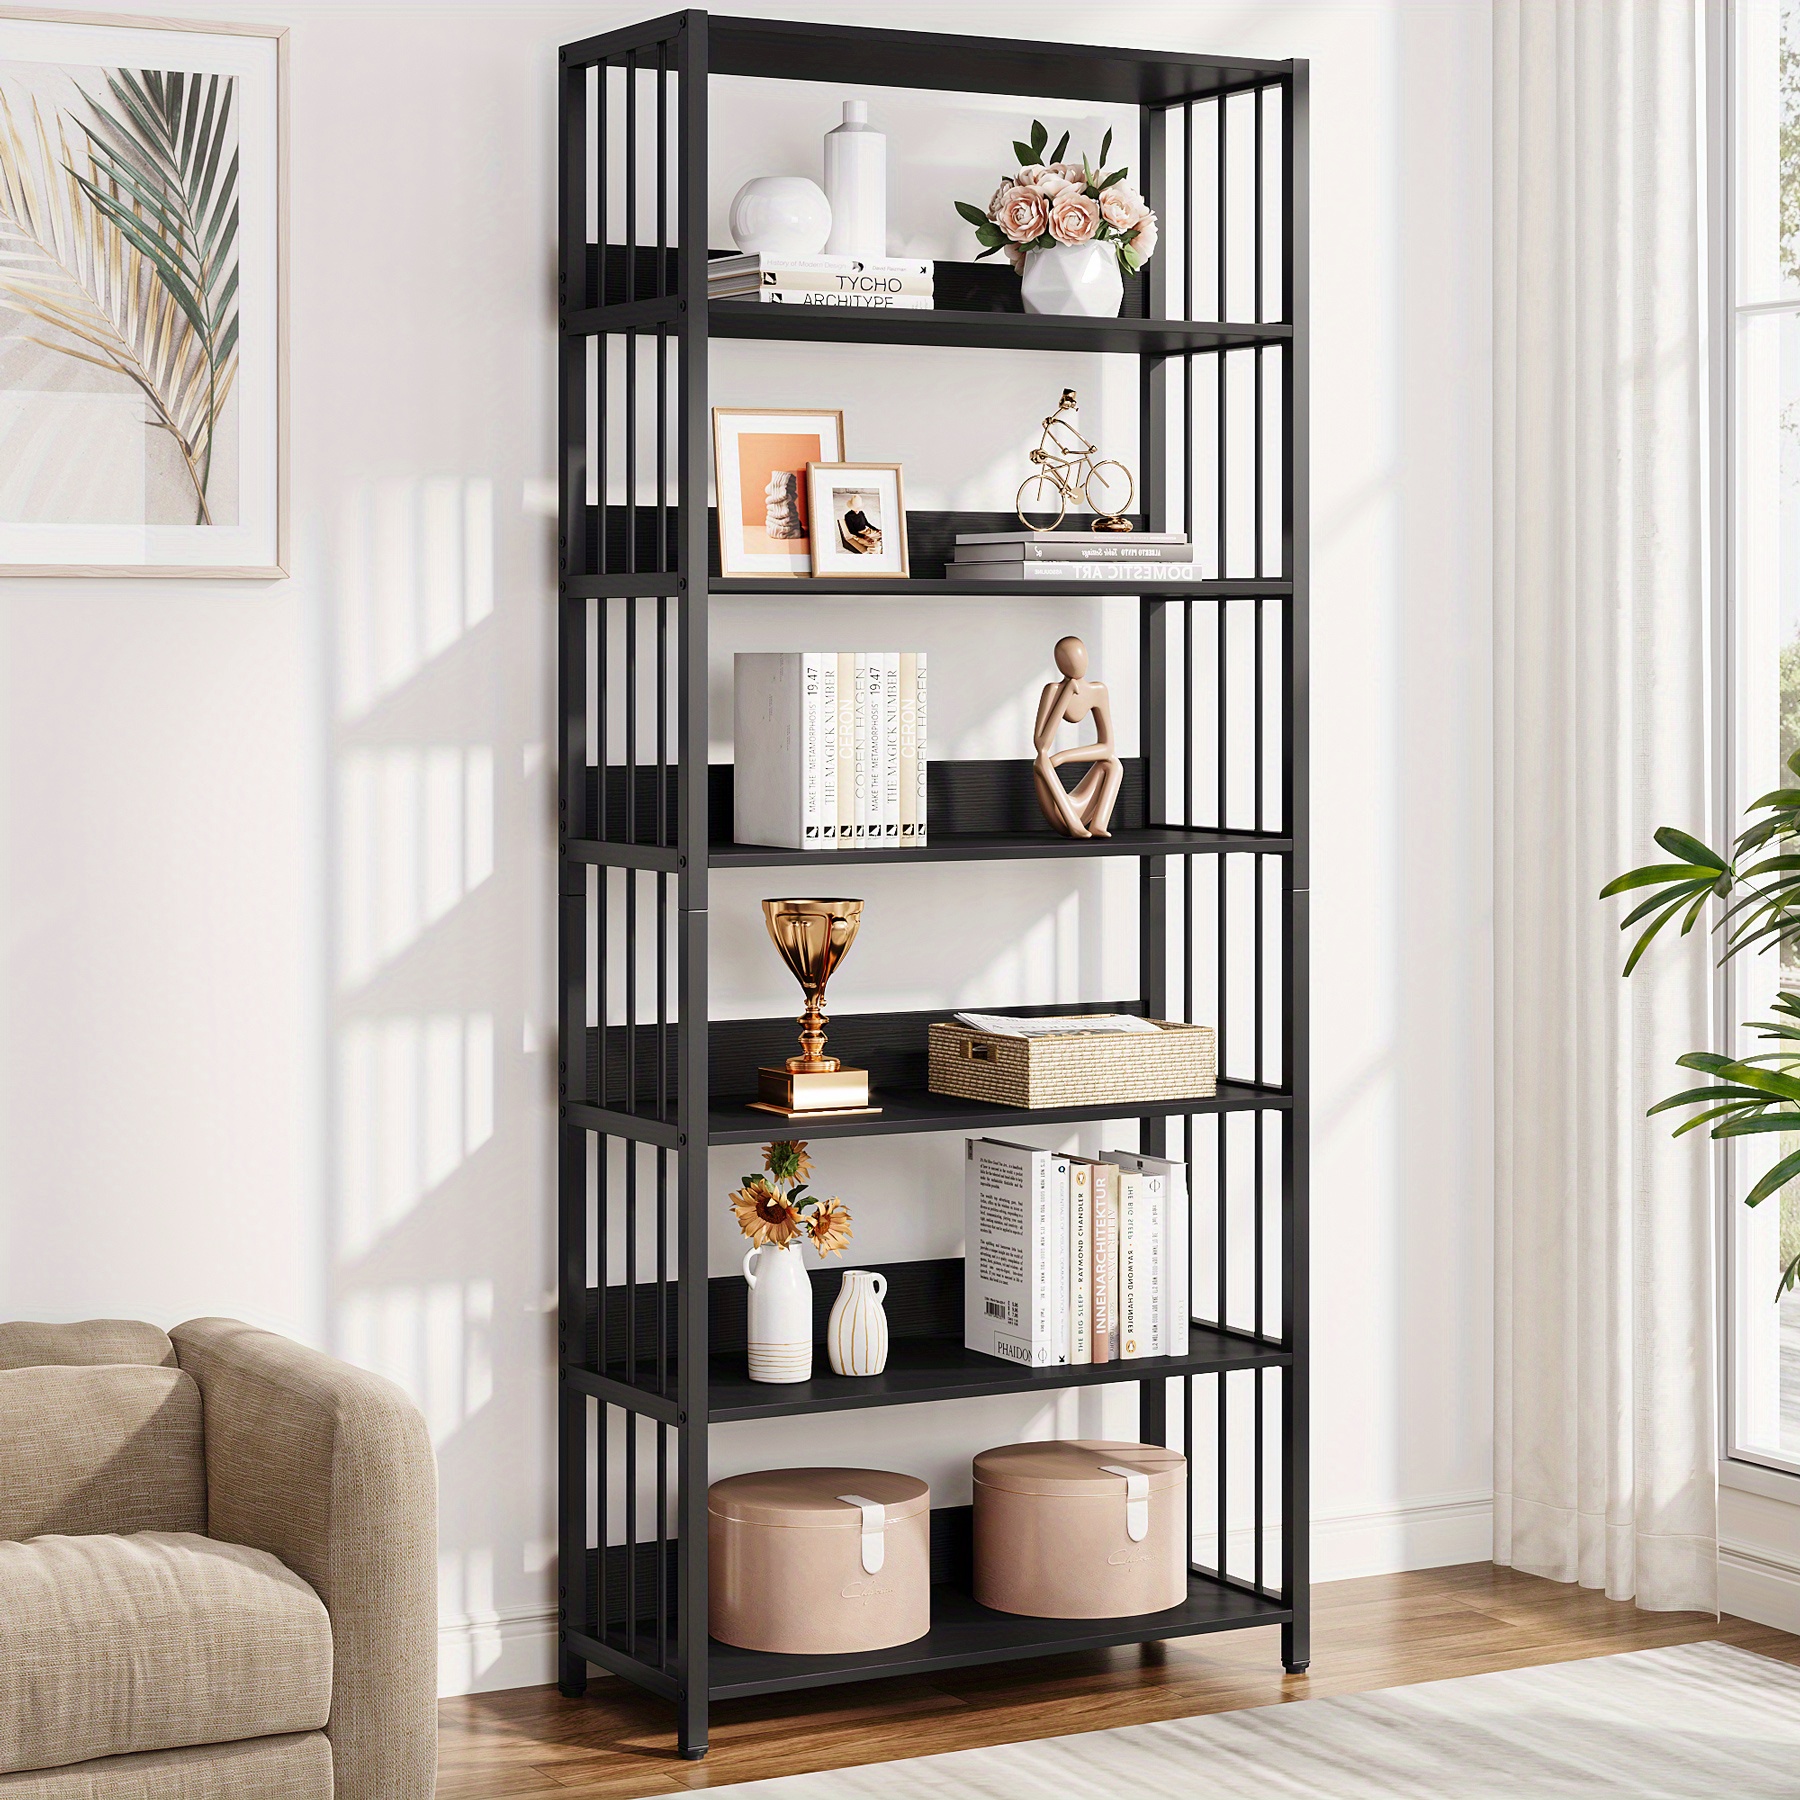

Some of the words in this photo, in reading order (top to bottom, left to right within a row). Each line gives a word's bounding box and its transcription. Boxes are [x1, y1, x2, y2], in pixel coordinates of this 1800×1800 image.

[767, 259, 789, 268] History
[835, 275, 902, 293] TYCHO
[803, 293, 894, 307] ARCHITYPE
[807, 667, 819, 696] 19,47
[869, 667, 881, 695] 19,47
[825, 670, 835, 723] NUMBER
[855, 668, 865, 728] HAGEN
[887, 670, 897, 722] NUMBER
[839, 699, 854, 759] CERON
[901, 698, 916, 758] CERON
[825, 727, 835, 777] MAGICK
[887, 726, 897, 776] MAGICK
[808, 775, 817, 789] THE
[855, 739, 865, 799] COPEN
[871, 774, 879, 788] THE
[808, 791, 817, 813] MAKE
[825, 781, 835, 805] THE
[871, 790, 879, 811] MAKE
[887, 780, 897, 804] THE
[1096, 1178, 1106, 1334] INNENARCHITEKTUR
